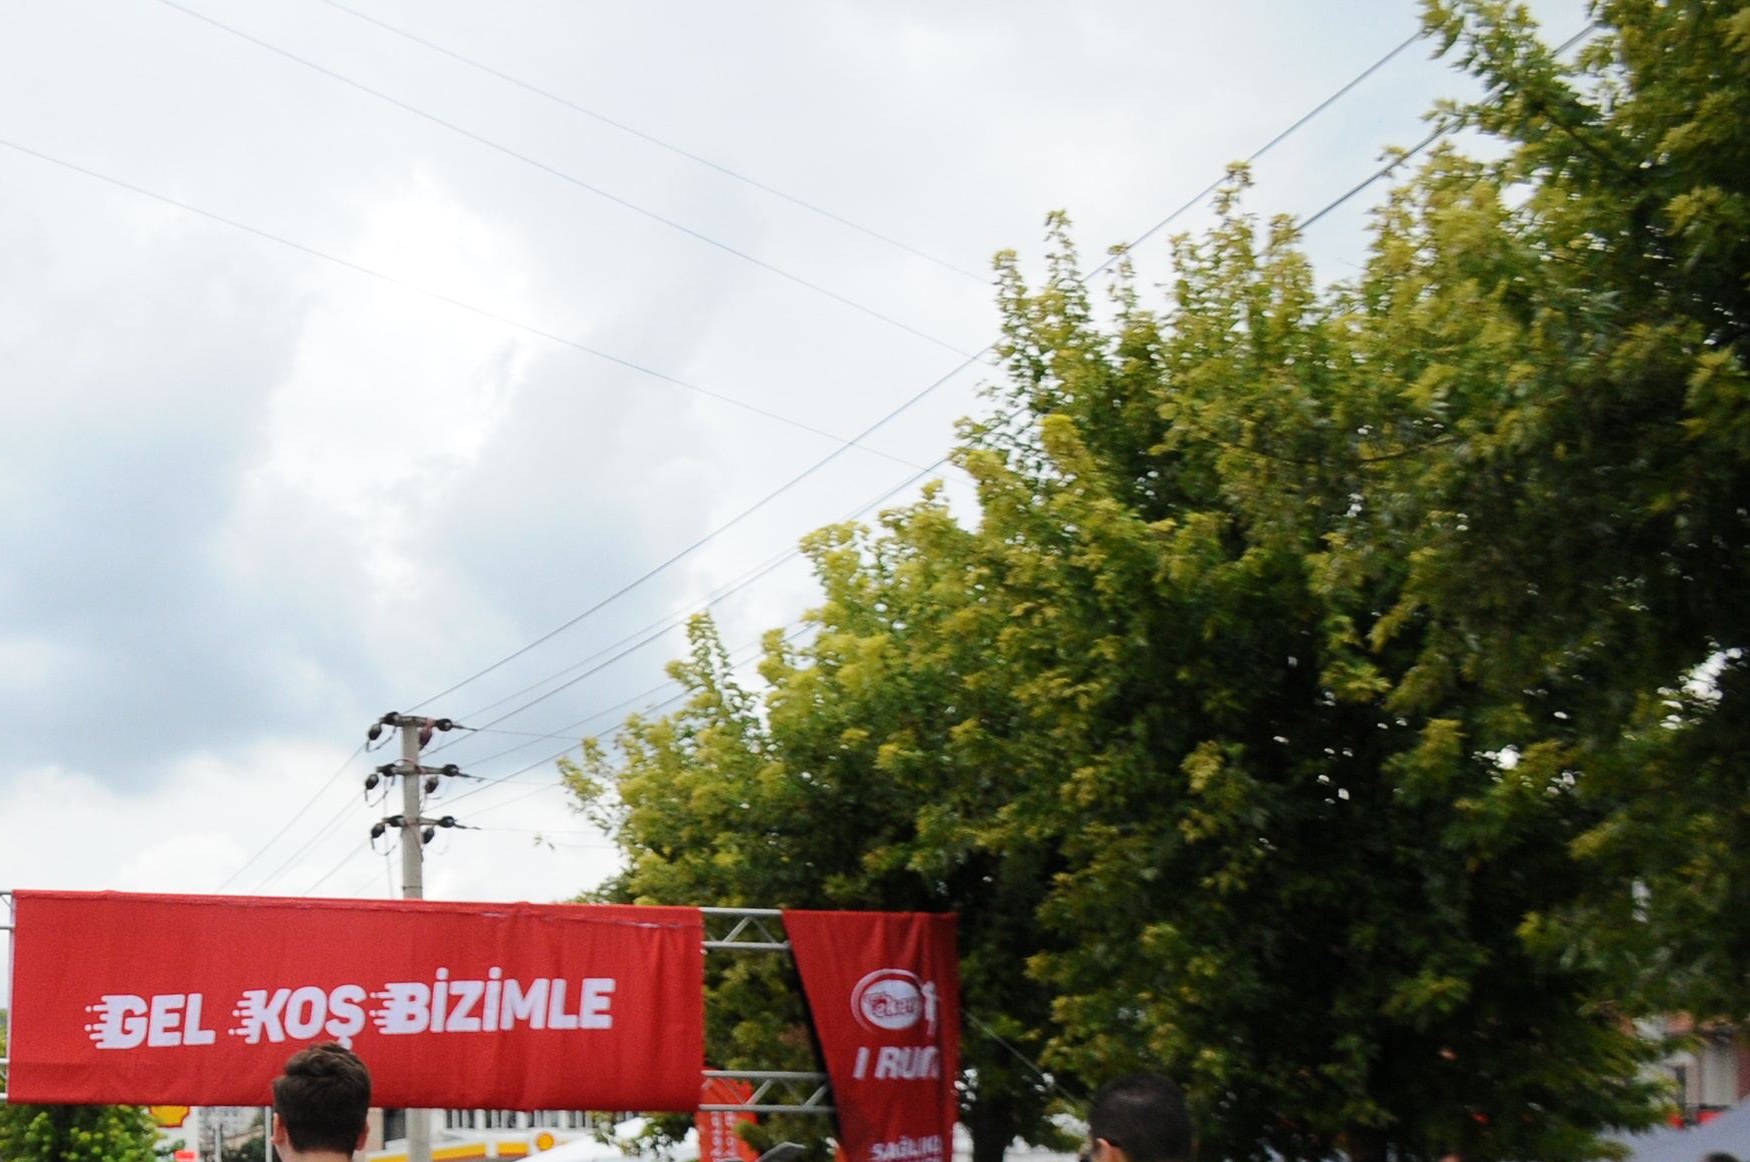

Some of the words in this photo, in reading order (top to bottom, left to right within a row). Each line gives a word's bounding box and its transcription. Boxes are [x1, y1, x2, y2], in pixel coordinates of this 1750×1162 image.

[90, 992, 216, 1050] GEL
[235, 984, 368, 1049] KOŞ
[376, 966, 616, 1035] BİZİMLE
